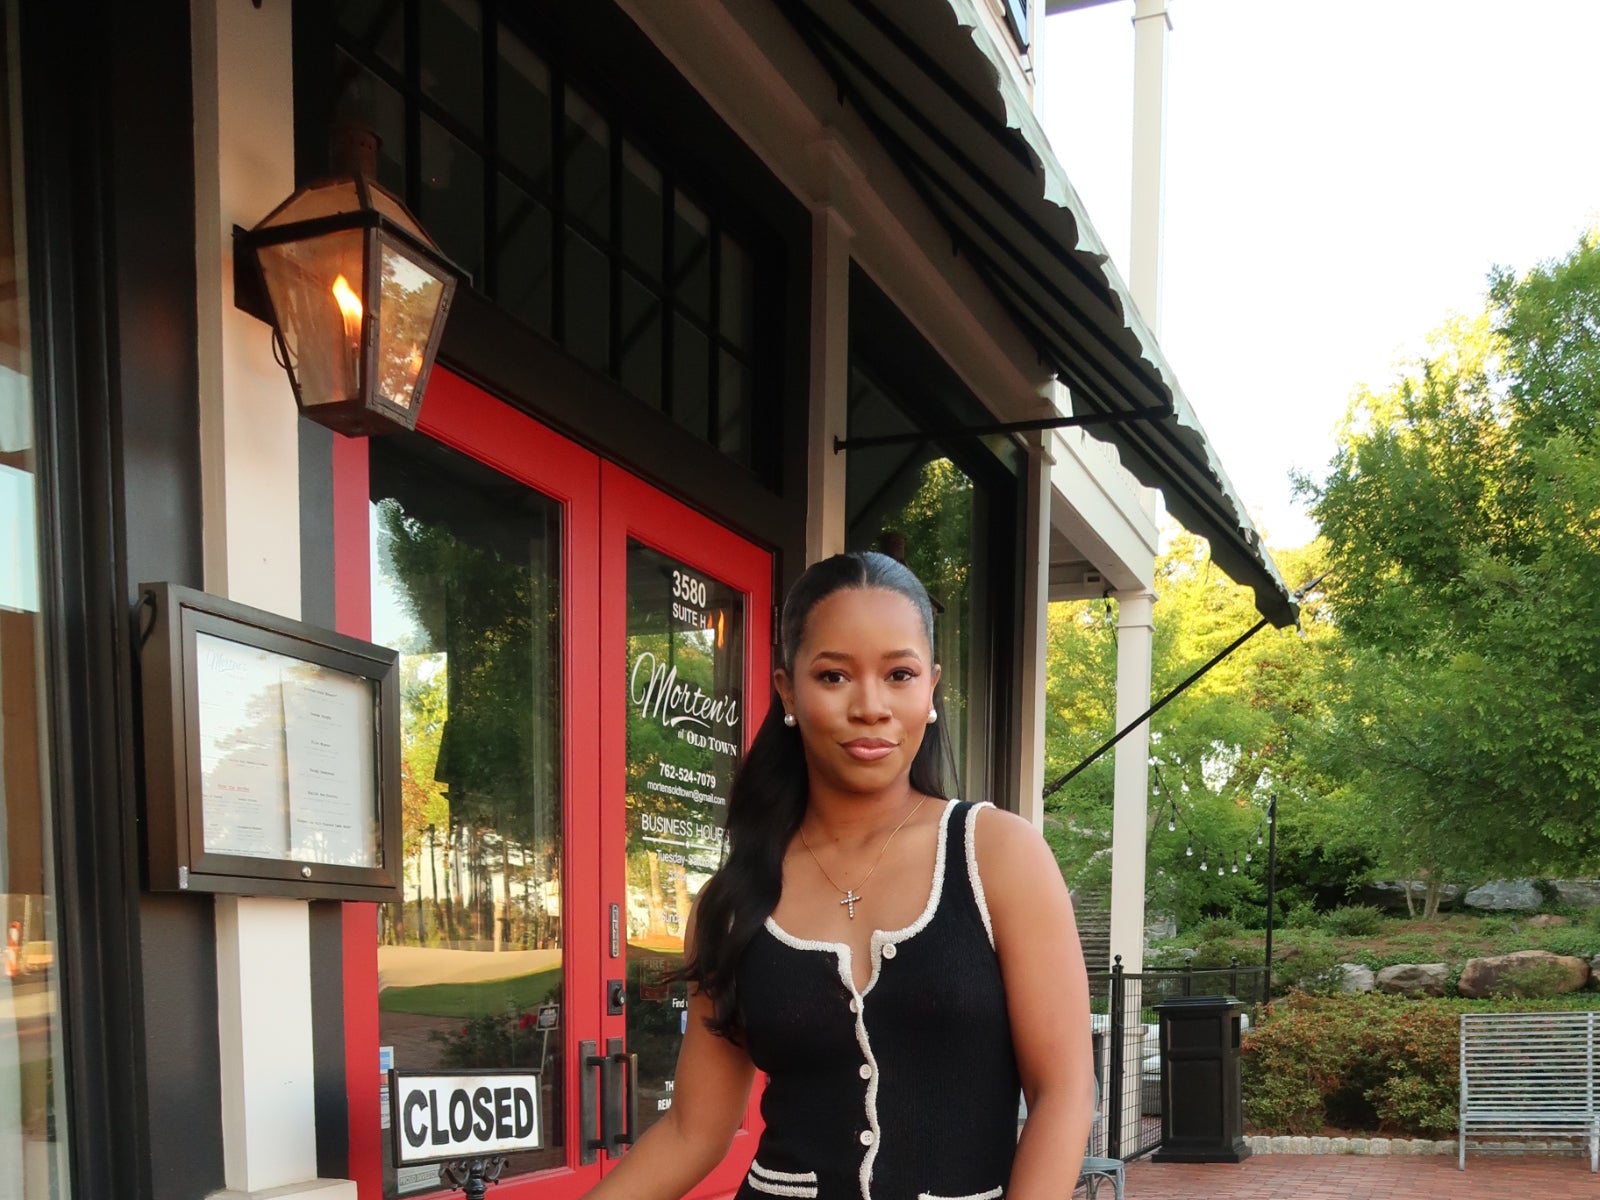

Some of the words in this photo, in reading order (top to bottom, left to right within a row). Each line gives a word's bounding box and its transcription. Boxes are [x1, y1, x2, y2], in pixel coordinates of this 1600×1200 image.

[672, 570, 706, 608] 3580
[672, 602, 698, 627] SUITE
[700, 613, 707, 629] H
[631, 651, 739, 727] Morten's
[687, 730, 707, 749] OLD
[708, 736, 738, 757] TOWN
[659, 762, 717, 789] 762-524-7079
[647, 781, 726, 806] mortensoldtown@gmail.com
[641, 813, 693, 837] BUSINESS
[403, 1086, 534, 1149] CLOSED
